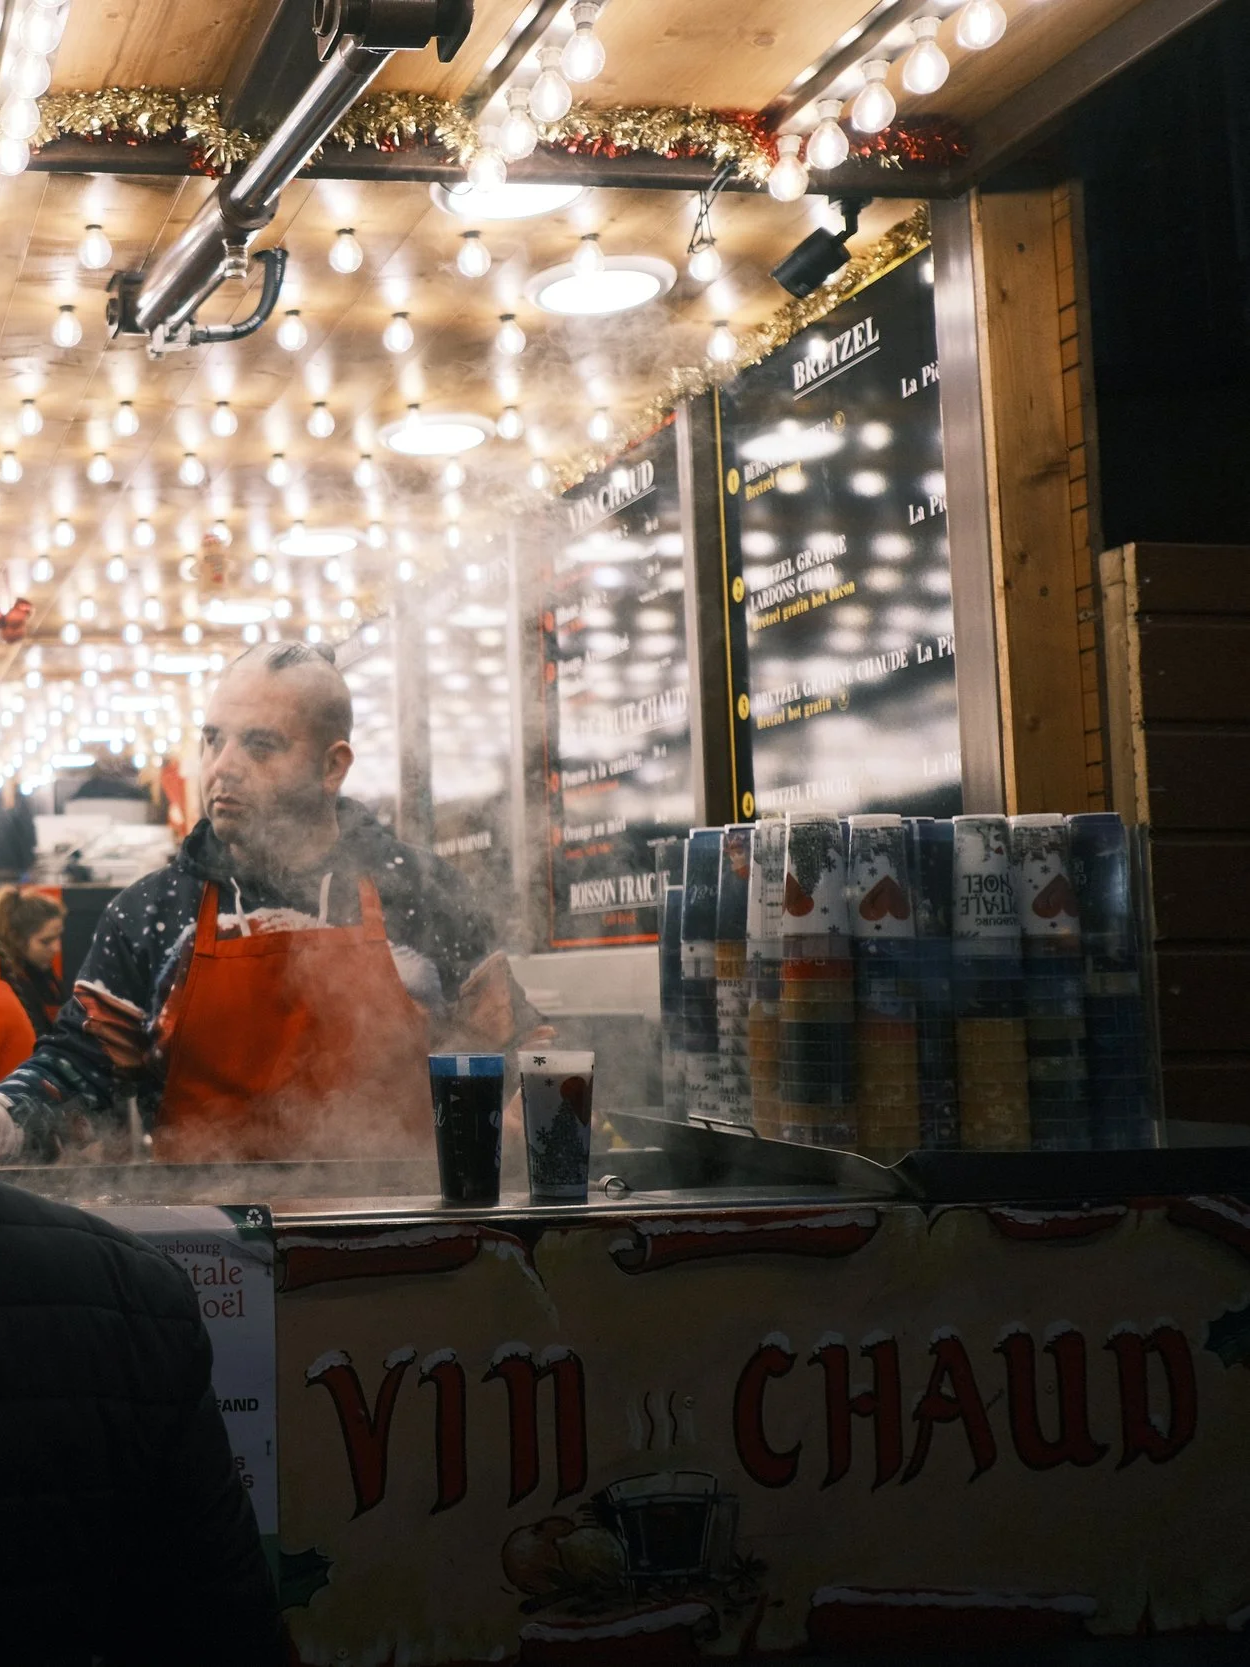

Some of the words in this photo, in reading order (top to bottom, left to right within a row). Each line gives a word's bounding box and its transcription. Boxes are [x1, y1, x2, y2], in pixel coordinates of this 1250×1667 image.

[792, 316, 880, 391] BRETZEL
[901, 377, 918, 399] La
[597, 460, 655, 514] CHAUD
[908, 504, 925, 526] La
[750, 558, 796, 593] TZEL
[750, 579, 796, 613] LARDONS
[856, 649, 909, 682] CHAUDE
[916, 642, 934, 665] La
[569, 878, 616, 909] BOISSON
[183, 1256, 243, 1286] tale
[196, 1290, 246, 1318] oël
[733, 1316, 1198, 1493] CHAUD
